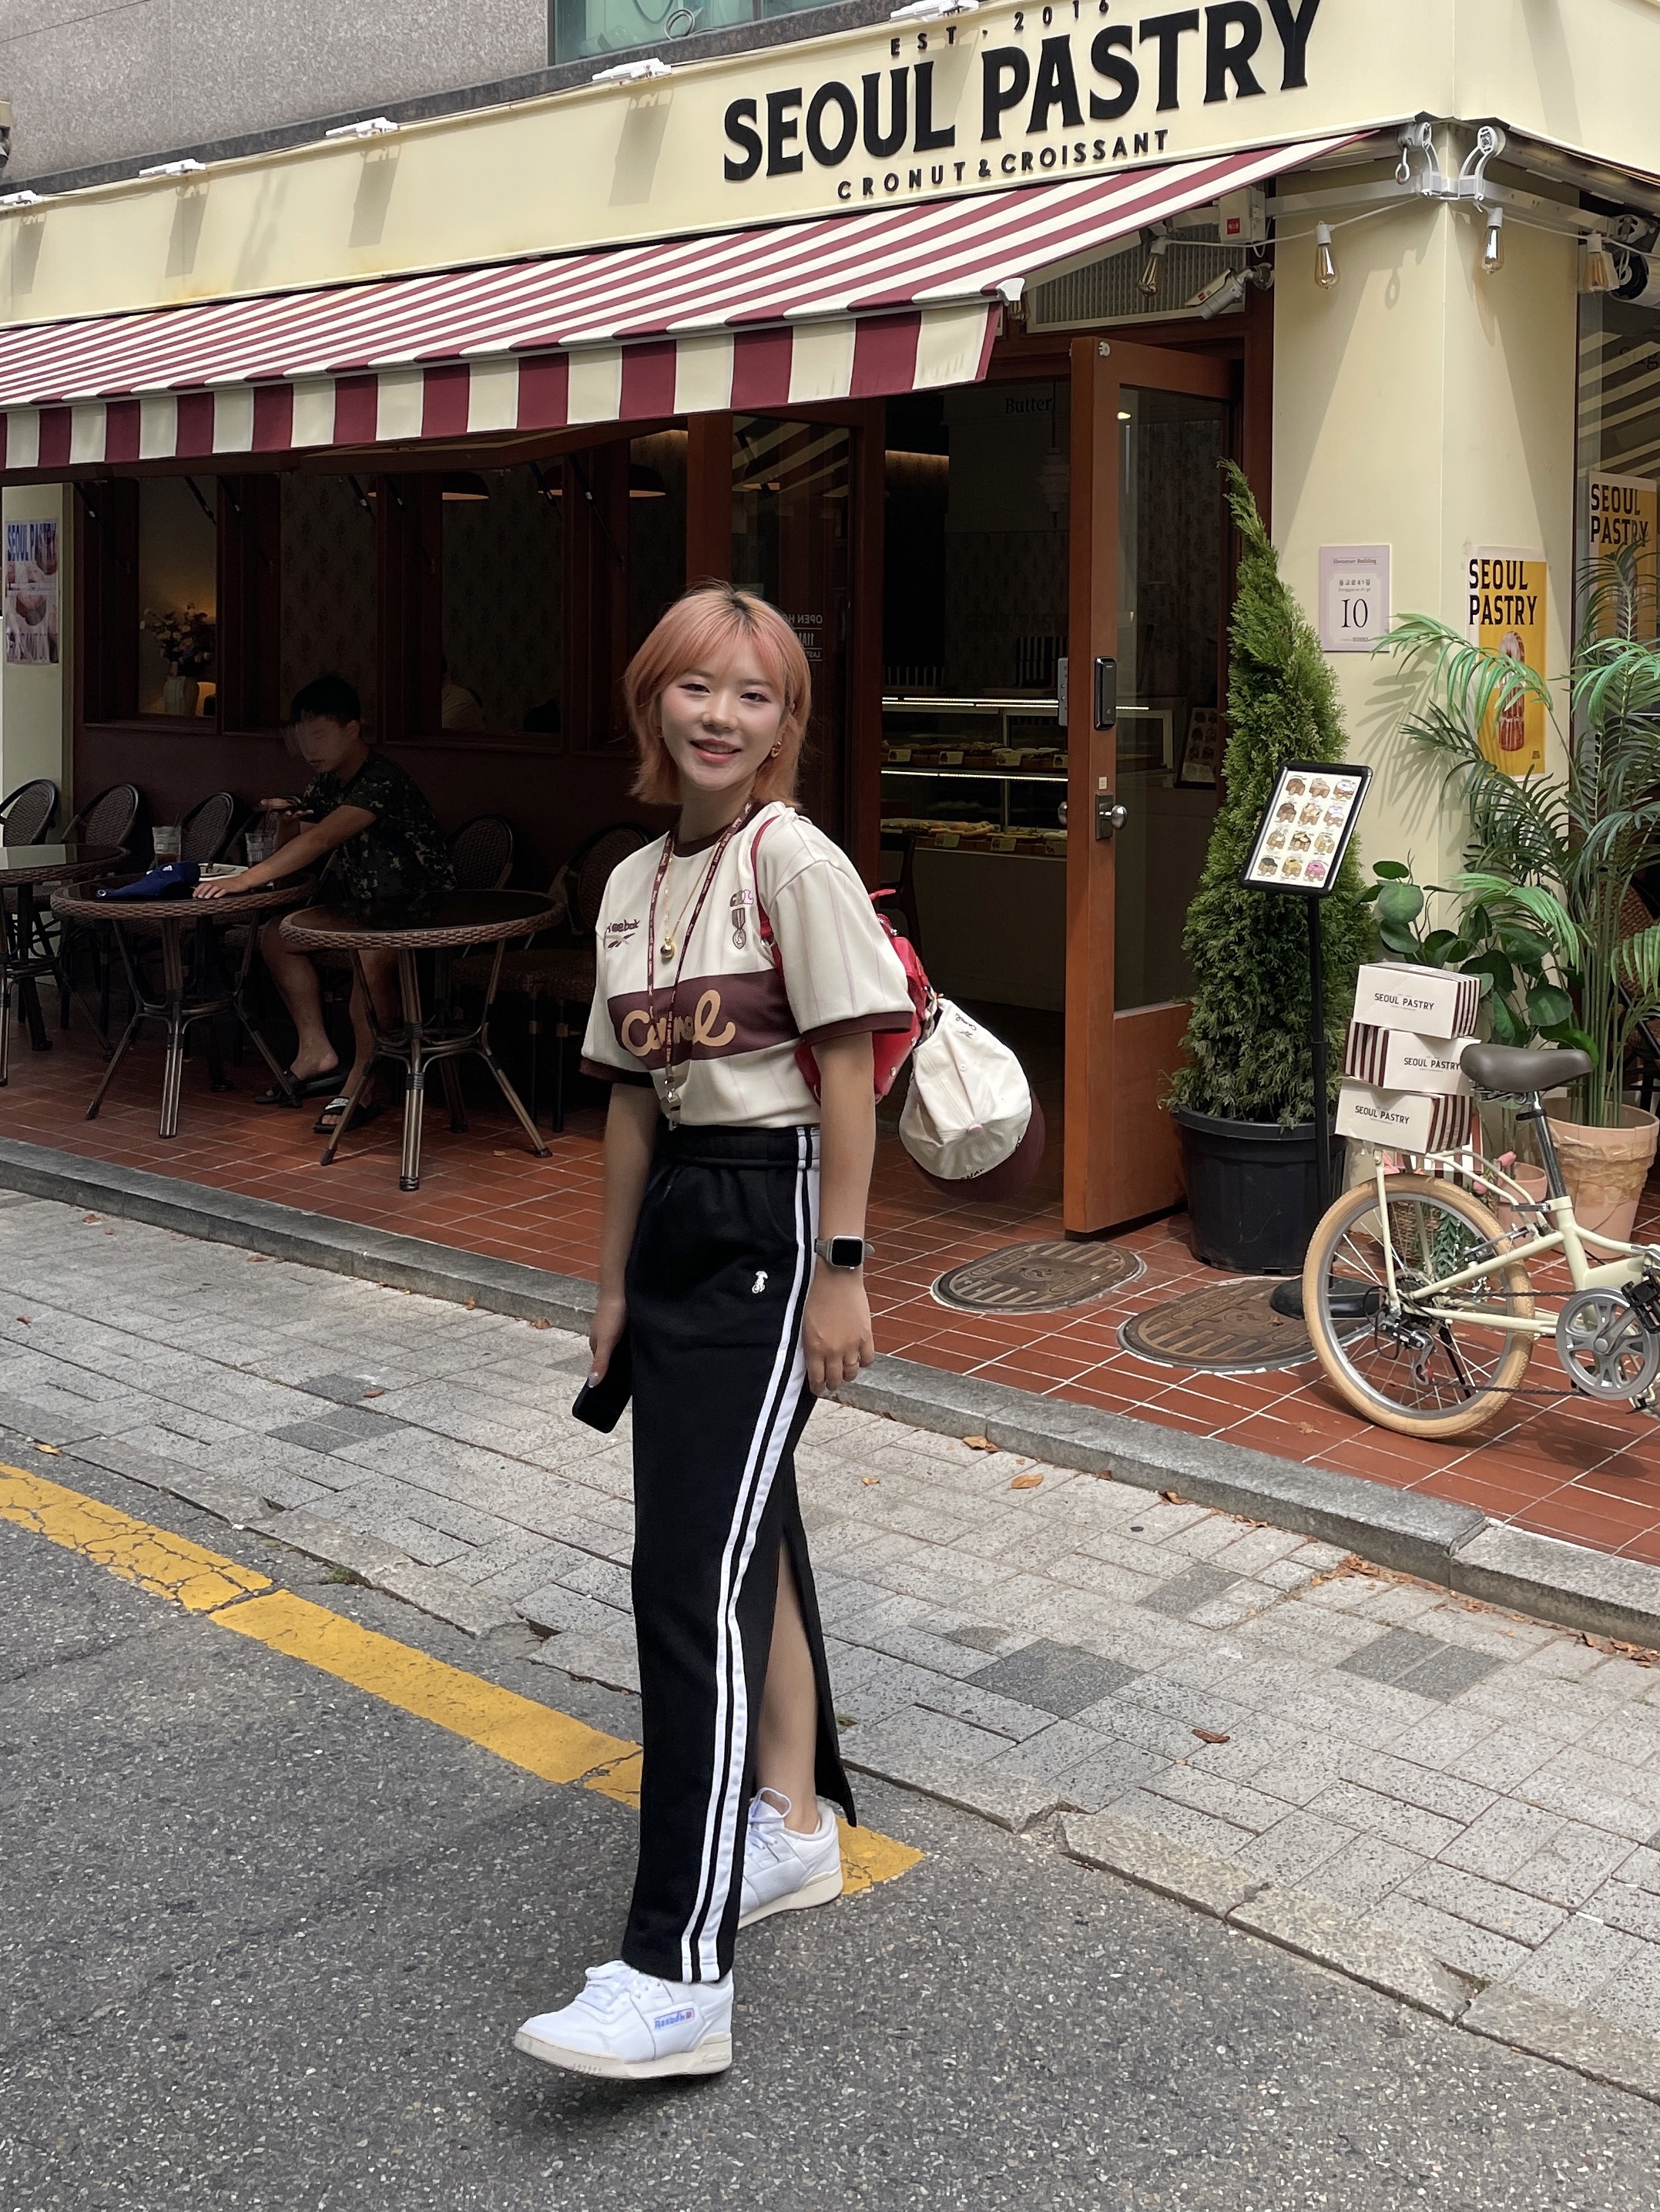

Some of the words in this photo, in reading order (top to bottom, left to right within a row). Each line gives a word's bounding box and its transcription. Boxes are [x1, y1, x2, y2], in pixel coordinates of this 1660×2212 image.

[1014, 0, 1109, 31] 2016
[724, 60, 956, 181] SEOUL
[980, 0, 1321, 142] PASTRY
[1001, 129, 1168, 174] CROISSANT
[1005, 398, 1052, 414] Butter
[1591, 483, 1642, 516] SEOUL
[1591, 515, 1649, 548] PASTRY
[1469, 559, 1529, 590] SEOUL
[1341, 599, 1368, 628] 10
[1469, 594, 1538, 626] PASTRY
[1374, 992, 1399, 1005] SEOUL
[1403, 998, 1434, 1010] PASTRY
[1403, 1057, 1427, 1067] SEOUL
[1430, 1059, 1460, 1070] PASTRY
[1355, 1105, 1377, 1118] SEOUL
[1380, 1110, 1410, 1124] PASTRY
